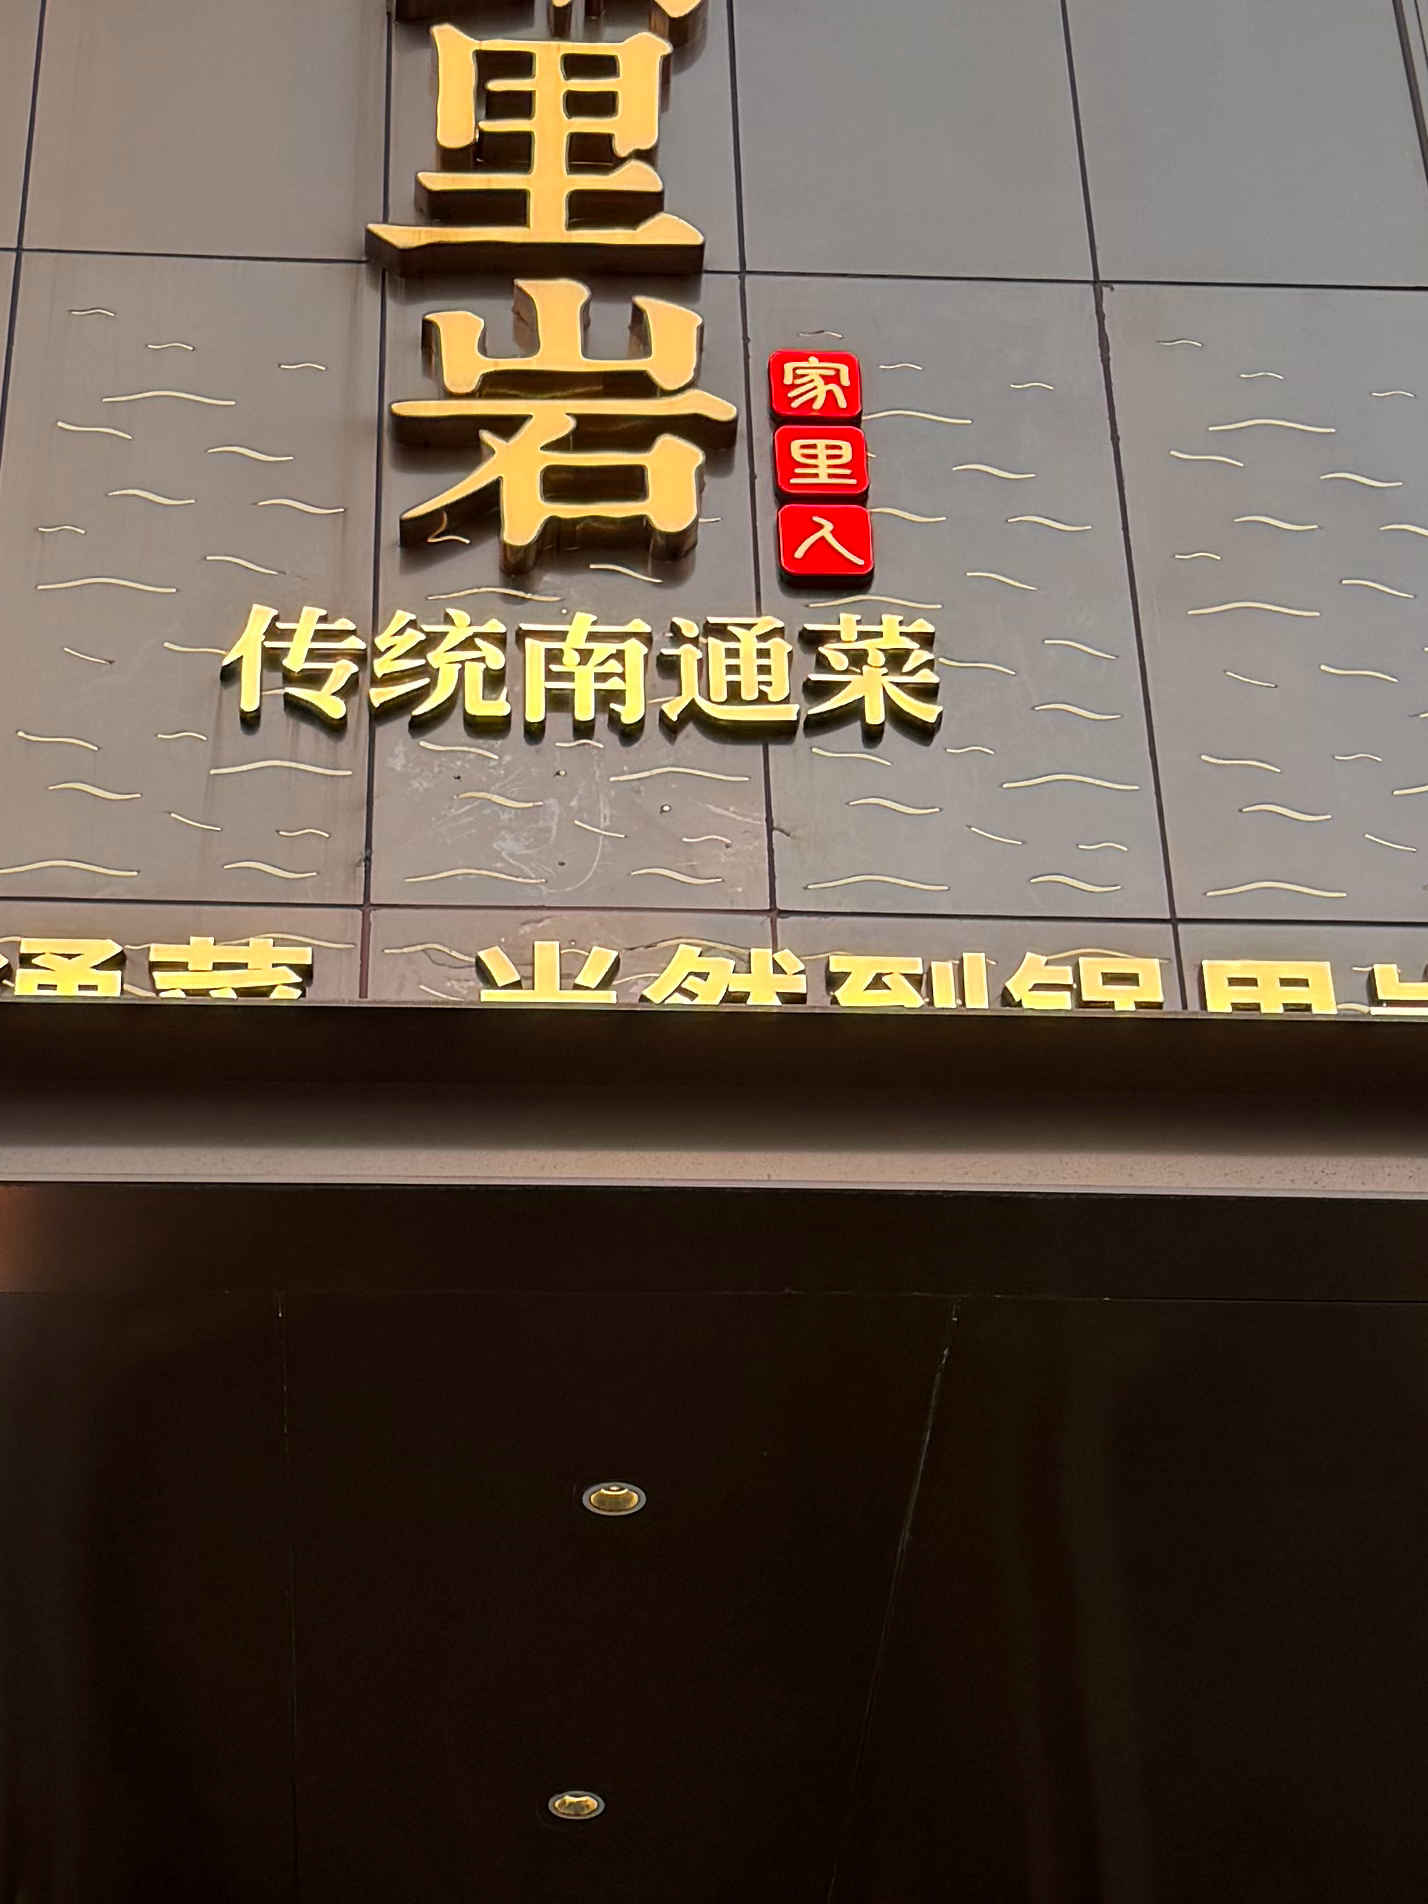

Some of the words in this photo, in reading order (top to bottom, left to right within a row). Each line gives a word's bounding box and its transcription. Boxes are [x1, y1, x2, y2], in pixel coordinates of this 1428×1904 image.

[221, 602, 945, 730] 传统南通菜
